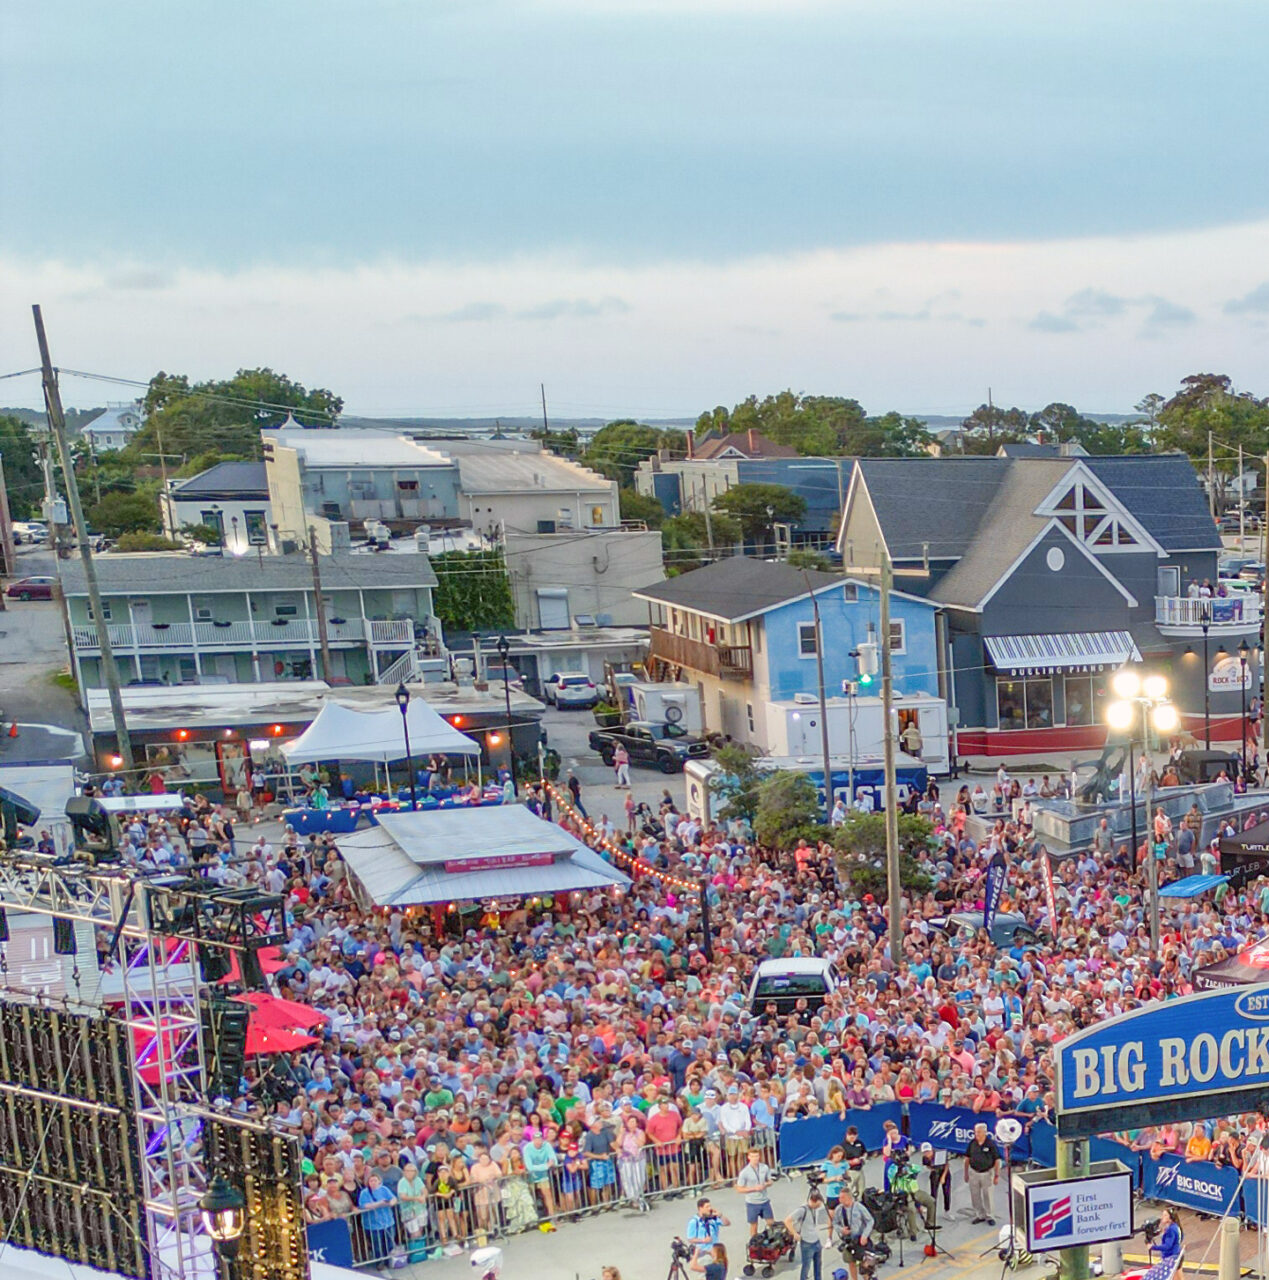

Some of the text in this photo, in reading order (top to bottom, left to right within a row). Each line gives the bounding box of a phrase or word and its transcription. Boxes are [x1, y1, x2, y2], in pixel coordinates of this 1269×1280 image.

[1011, 666, 1062, 676] DUELING
[1069, 664, 1104, 674] PIANO
[1247, 995, 1269, 1010] EST
[1072, 1040, 1147, 1099] BIG
[955, 1127, 975, 1140] BIG
[1177, 1174, 1193, 1189] BIG
[1194, 1179, 1223, 1198] ROCK
[1076, 1193, 1097, 1204] First
[1076, 1202, 1114, 1214] Citizens
[1076, 1212, 1101, 1223] Bank
[1077, 1220, 1126, 1235] forever first
